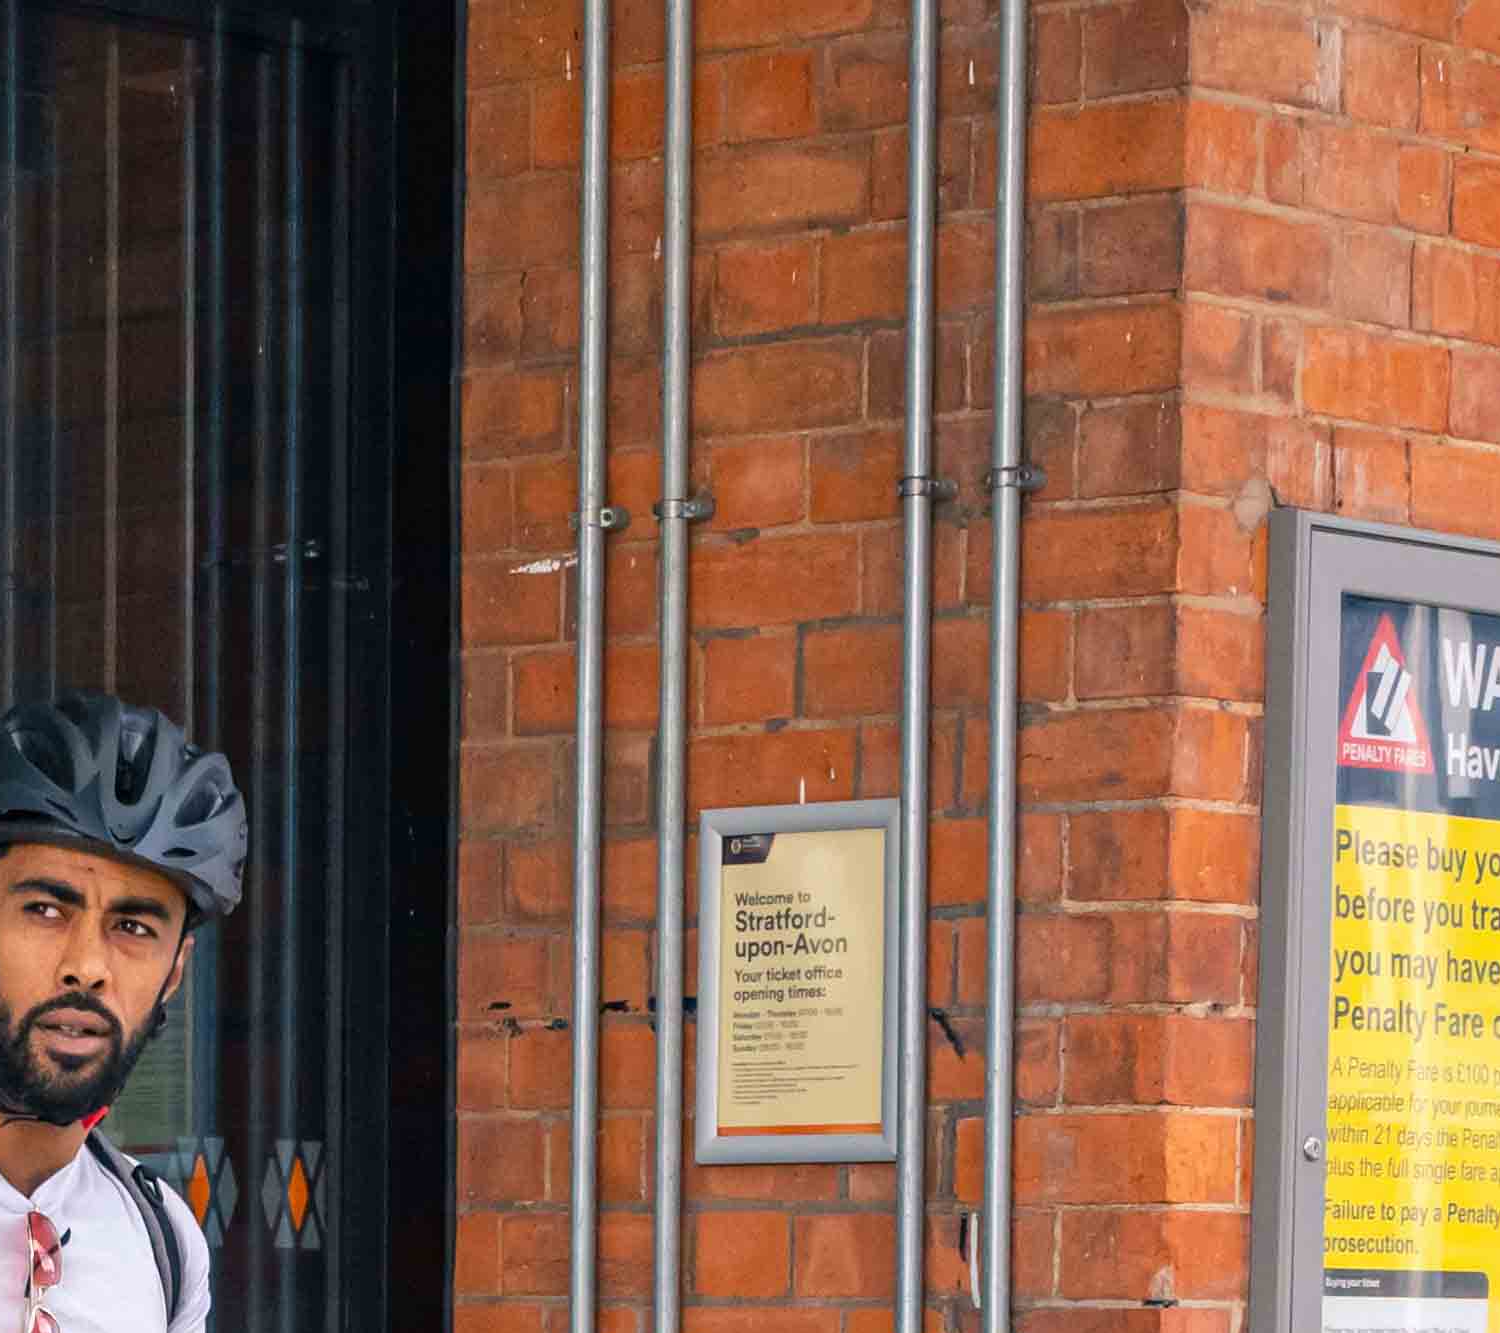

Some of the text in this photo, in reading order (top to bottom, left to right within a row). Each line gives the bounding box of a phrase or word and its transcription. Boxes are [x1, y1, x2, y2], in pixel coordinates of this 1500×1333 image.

[1342, 742, 1393, 766] PENALTY
[1335, 829, 1419, 870] Please
[1426, 836, 1467, 877] buy
[735, 891, 811, 906] Welcome to
[1335, 885, 1416, 926] before
[1423, 900, 1464, 935] you
[735, 906, 836, 933] Stratford-
[735, 933, 848, 962] upon-Avon
[734, 965, 843, 984] Your ticket office
[1334, 948, 1382, 982] you
[1390, 955, 1439, 988] may
[1446, 950, 1500, 987] have
[733, 985, 827, 1004] opening times:
[1333, 995, 1425, 1044] Penalty
[1433, 1003, 1484, 1039] Fare
[1348, 1056, 1402, 1088] Penalty
[1407, 1059, 1439, 1083] Fare
[1455, 1063, 1489, 1085] £100
[1327, 1091, 1405, 1116] applicable
[1432, 1098, 1462, 1121] your
[1374, 1123, 1392, 1145] 21
[1397, 1125, 1433, 1152] days
[1436, 1128, 1459, 1148] the
[1360, 1156, 1385, 1179] the
[1388, 1156, 1409, 1179] full
[1413, 1160, 1457, 1185] single
[1461, 1160, 1487, 1182] fare
[1324, 1198, 1376, 1222] Failure
[1381, 1201, 1396, 1222] to
[1400, 1205, 1429, 1226] pay
[1433, 1207, 1443, 1223] a
